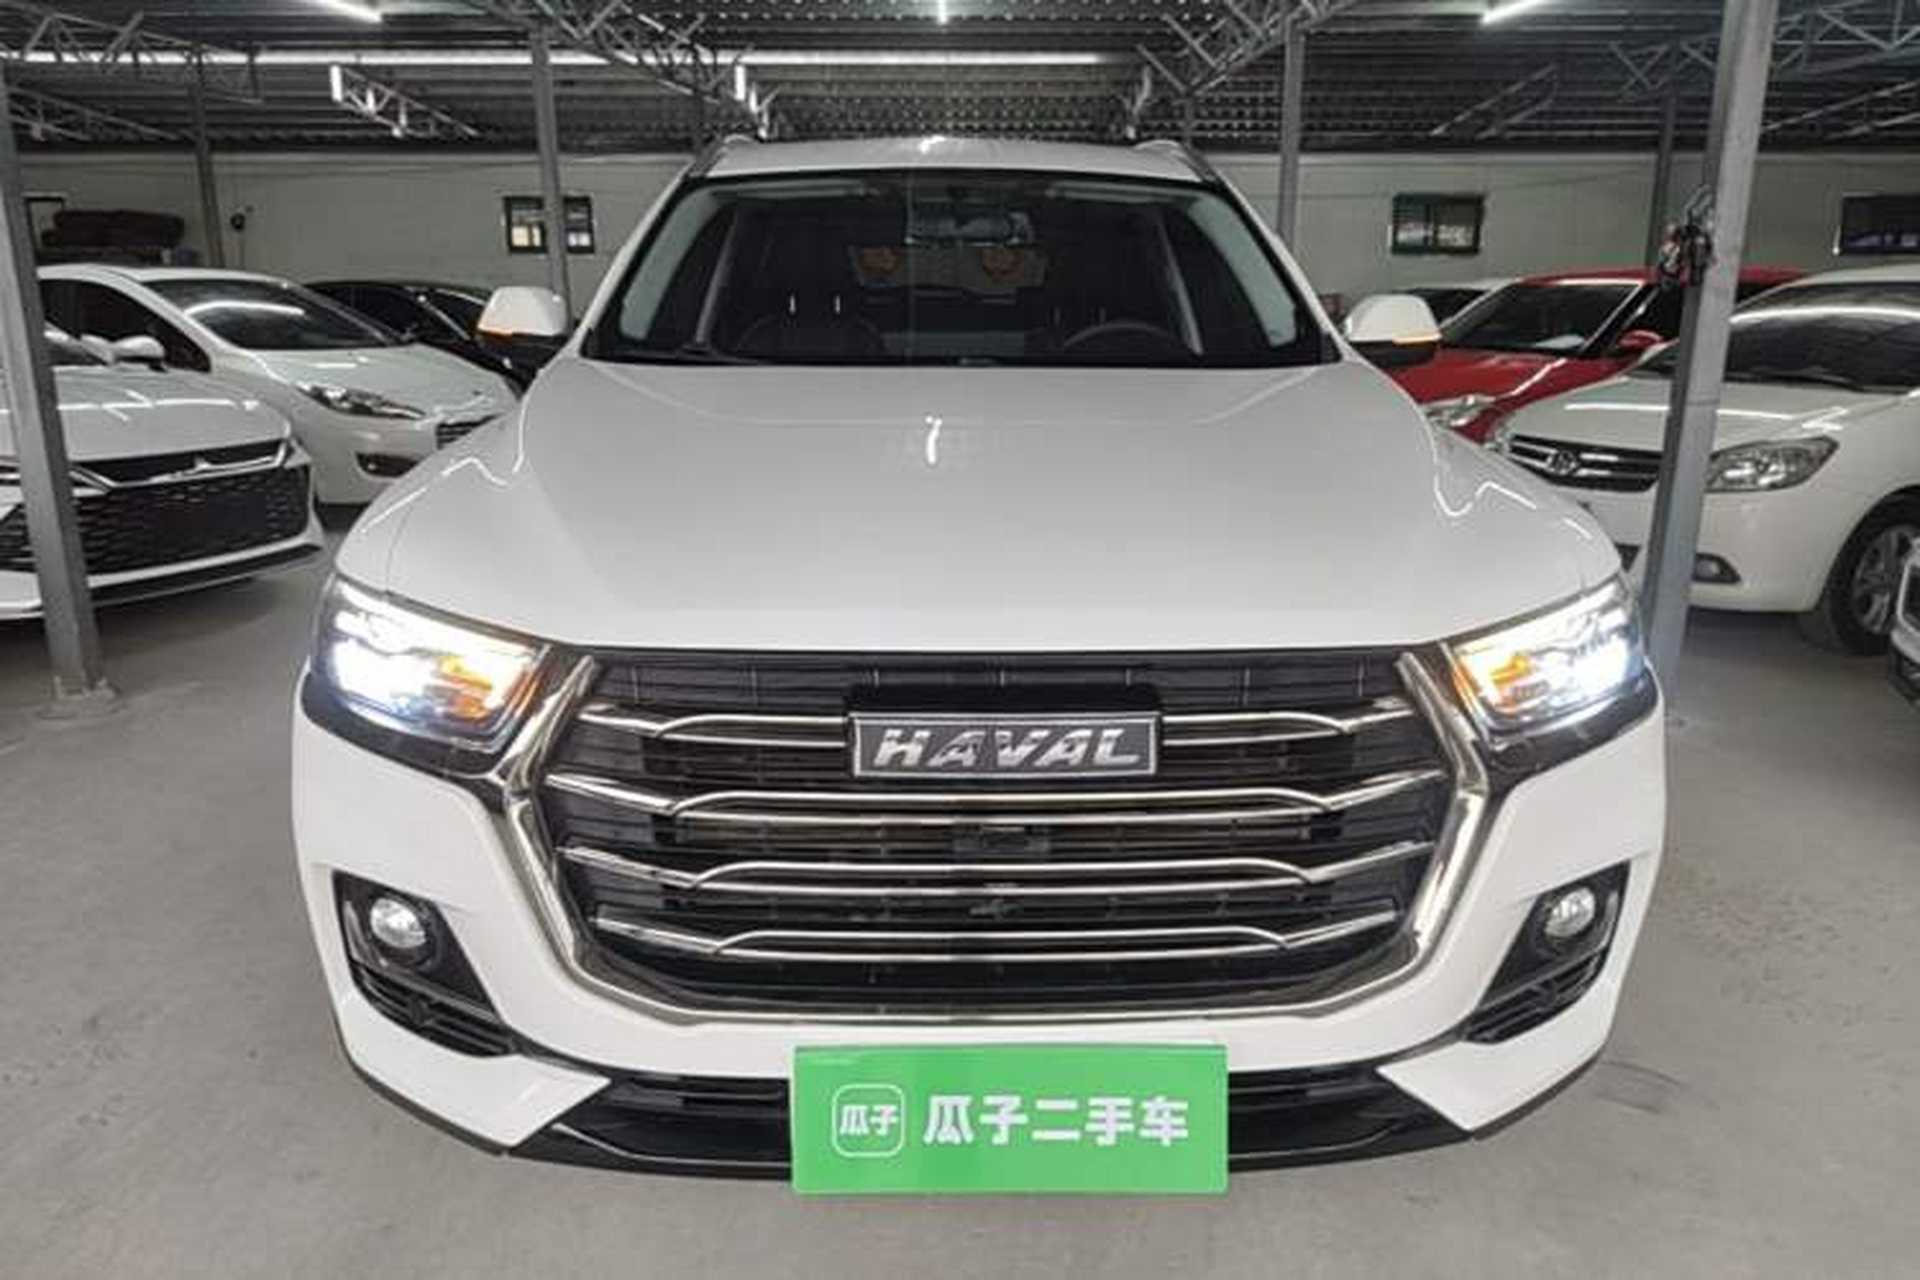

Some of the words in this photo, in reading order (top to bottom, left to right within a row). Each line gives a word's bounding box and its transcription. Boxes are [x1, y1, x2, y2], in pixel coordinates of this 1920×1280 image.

[873, 728, 1140, 767] HAVAL
[839, 1103, 899, 1137] 瓜子
[923, 1094, 1189, 1147] 瓜子二手车
